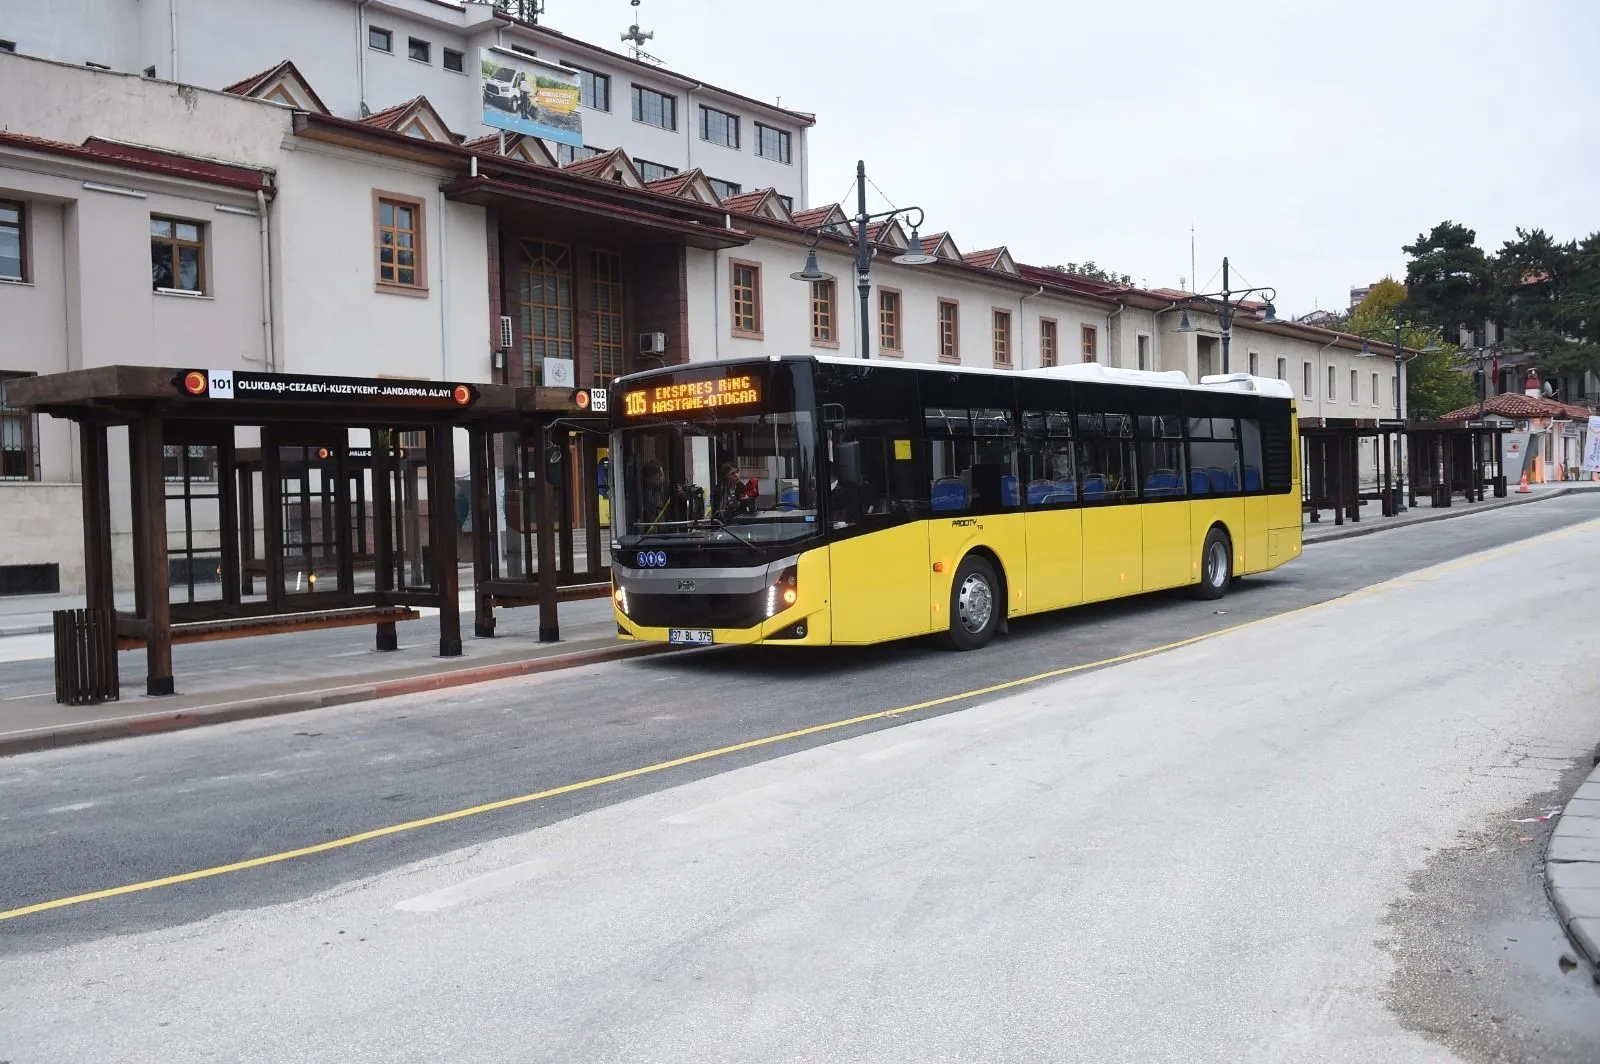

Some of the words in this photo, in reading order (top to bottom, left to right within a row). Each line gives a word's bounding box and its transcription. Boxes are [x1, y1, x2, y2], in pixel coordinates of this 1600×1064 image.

[212, 379, 231, 389] 101
[238, 380, 427, 397] OLUKBAŞI-CEZAEVİ-KUZEYKENT-JANDARMA
[428, 389, 451, 398] ALAYI
[592, 390, 605, 399] 102
[656, 381, 713, 400] EKSPRES
[593, 401, 606, 410] 105
[626, 391, 647, 416] 105
[673, 630, 681, 641] 37
[686, 631, 694, 641] BL
[698, 631, 712, 642] 375
